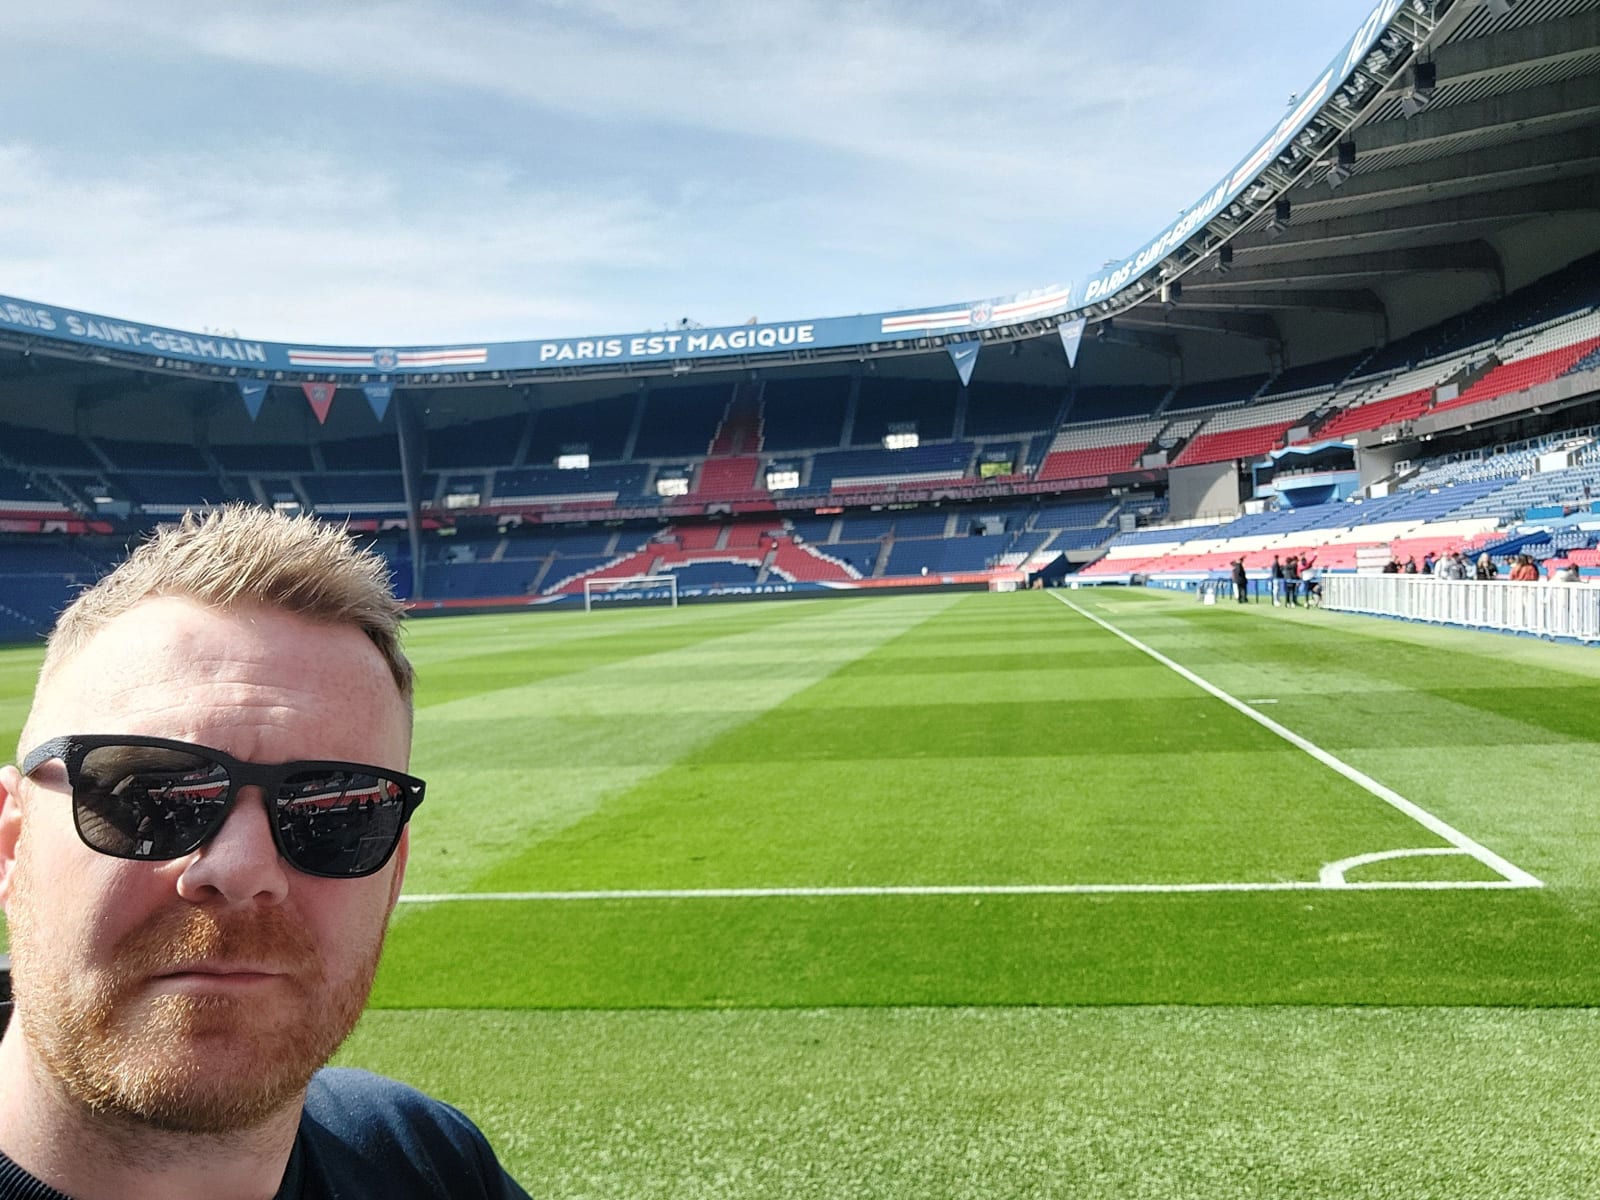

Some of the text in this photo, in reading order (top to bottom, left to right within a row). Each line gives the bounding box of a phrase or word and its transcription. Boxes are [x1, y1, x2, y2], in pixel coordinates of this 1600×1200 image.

[1085, 261, 1133, 302] PARIS
[0, 304, 267, 362] ARIS SAINT-GERMAIN
[540, 325, 815, 361] PARIS EST MAGIQUE
